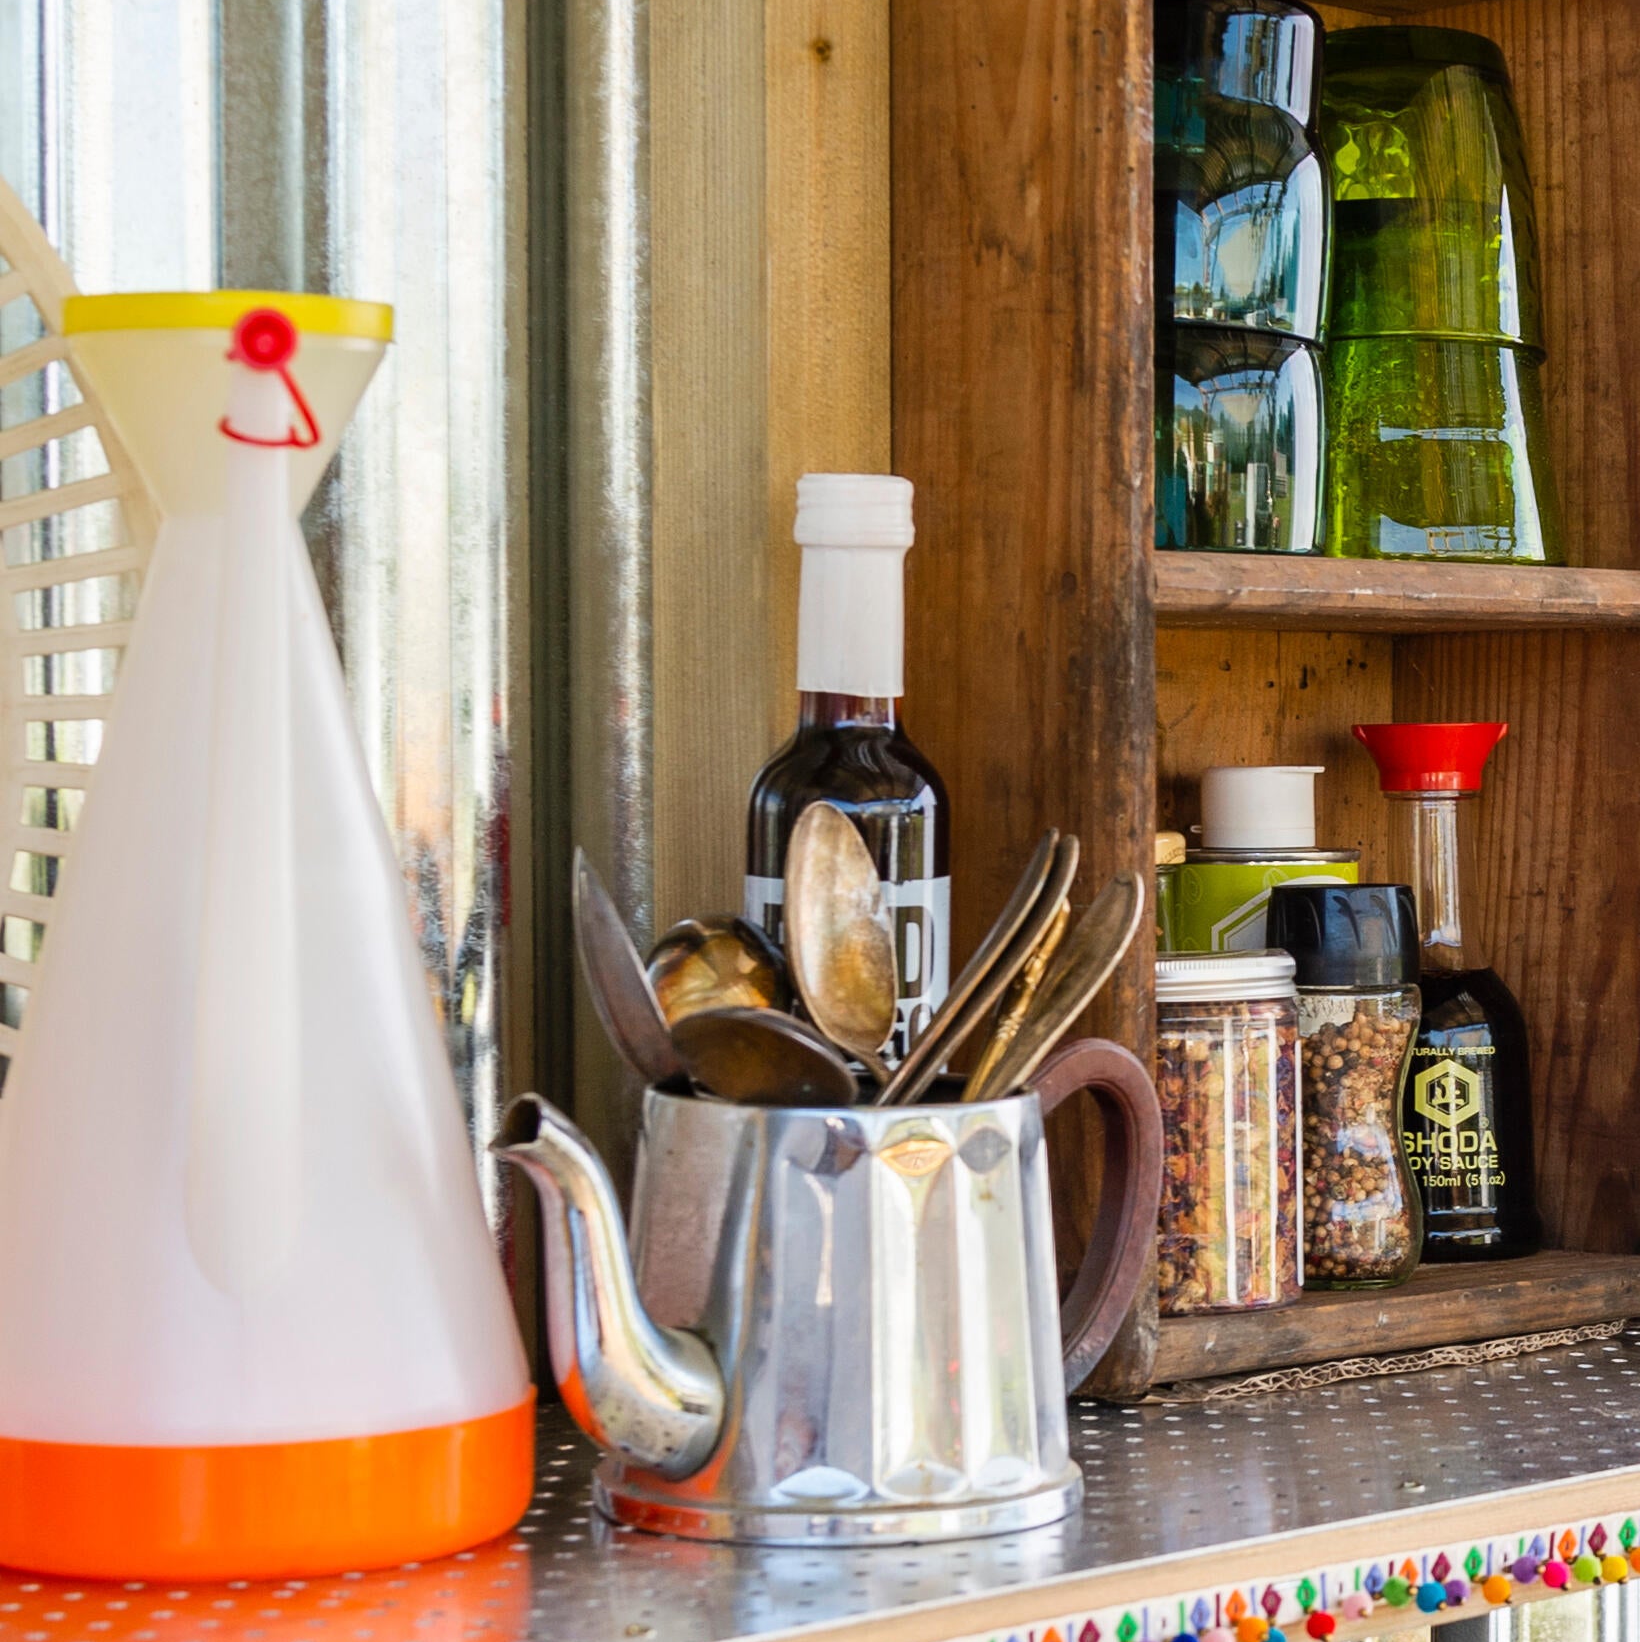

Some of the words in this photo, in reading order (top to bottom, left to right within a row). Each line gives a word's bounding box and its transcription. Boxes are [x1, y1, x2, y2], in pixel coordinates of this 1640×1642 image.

[1411, 1047, 1455, 1056] TURALLY
[1457, 1046, 1496, 1056] BREWED
[1402, 1130, 1498, 1153] SHODA
[1410, 1156, 1434, 1170] OY
[1440, 1155, 1499, 1170] SAUCE
[1422, 1175, 1461, 1187] 150ml
